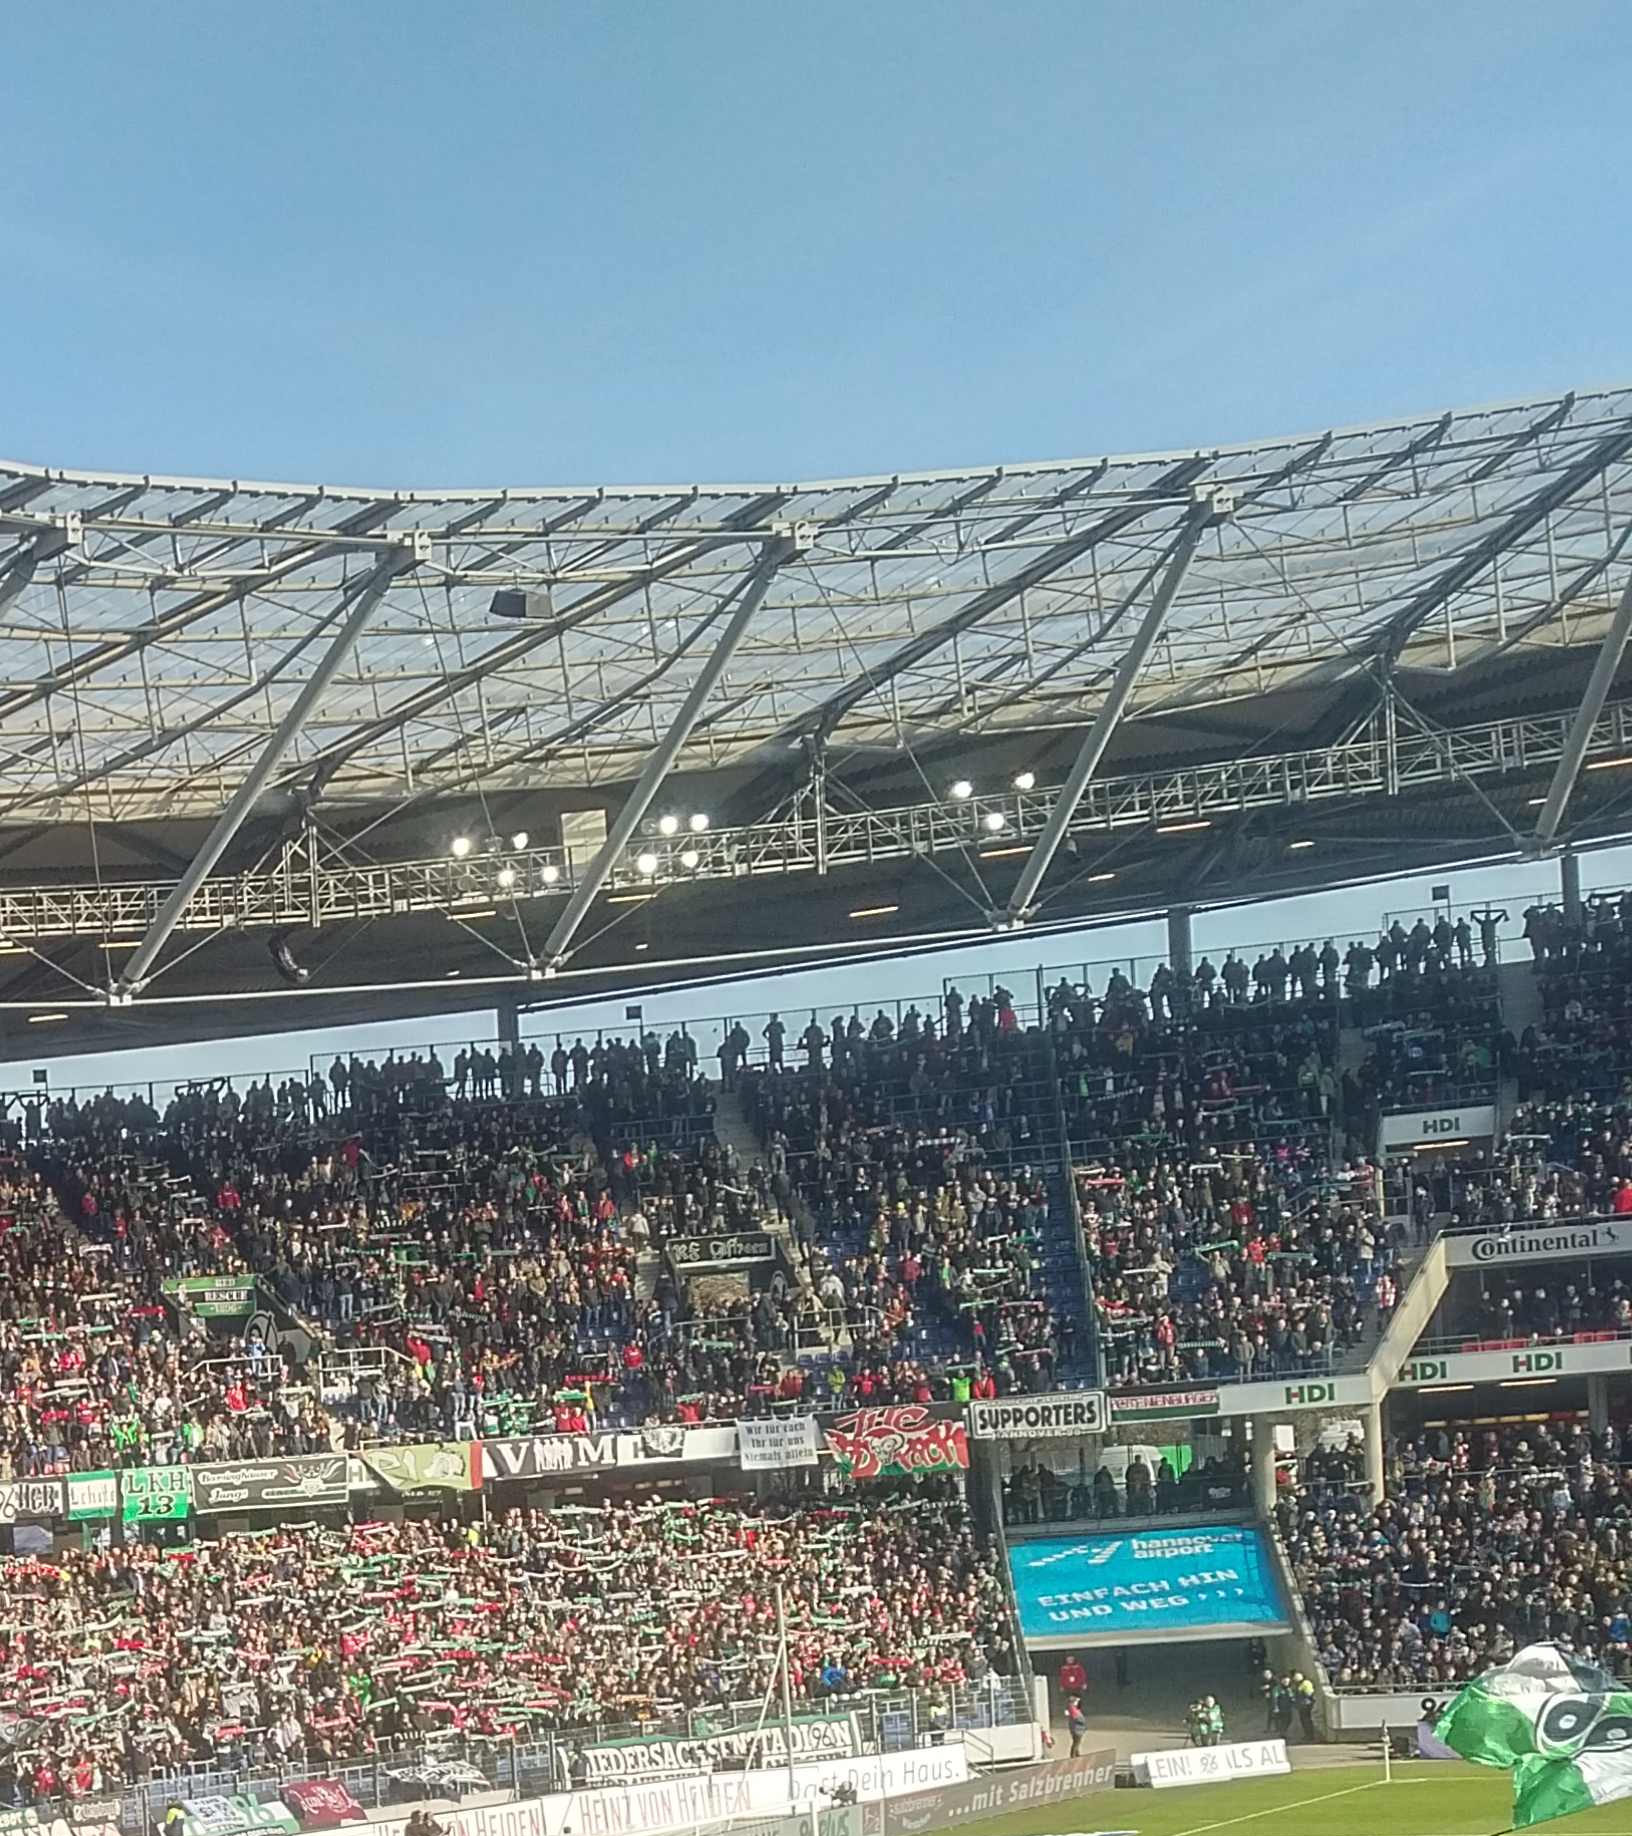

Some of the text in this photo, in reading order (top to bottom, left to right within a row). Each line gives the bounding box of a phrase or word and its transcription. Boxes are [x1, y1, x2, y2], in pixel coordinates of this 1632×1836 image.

[1423, 1117, 1460, 1134] HDI
[1472, 1229, 1597, 1260] Continental
[204, 1290, 247, 1302] RESCUE
[1398, 1361, 1447, 1382] HDI
[1512, 1352, 1563, 1373] HDI
[1285, 1382, 1335, 1404] HDI
[978, 1398, 1097, 1431] SUPPORTERS
[125, 1472, 186, 1495] LKH
[138, 1495, 173, 1516] 13
[1132, 1531, 1243, 1550] hannover
[1134, 1543, 1215, 1560] airport
[1039, 1569, 1239, 1607] EINFACH HIN
[1049, 1595, 1190, 1621] UND WEG
[903, 1757, 960, 1783] Haus.
[1008, 1762, 1114, 1804] Salzbrenner
